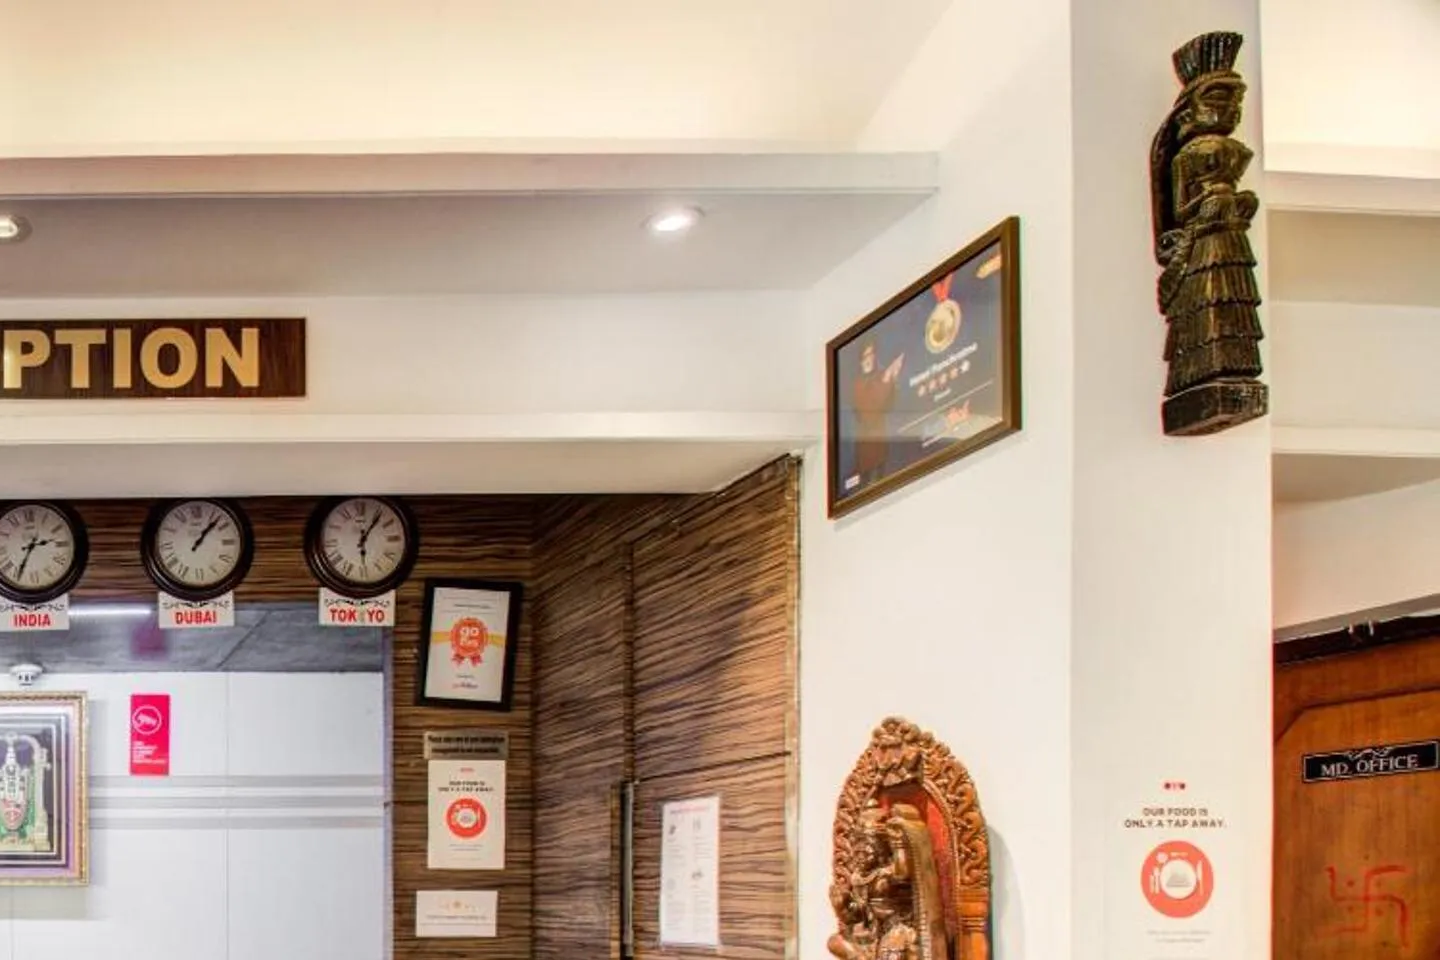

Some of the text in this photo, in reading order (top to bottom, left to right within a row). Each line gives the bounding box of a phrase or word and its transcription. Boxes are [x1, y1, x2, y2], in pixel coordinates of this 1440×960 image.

[13, 612, 51, 628] INDIA
[175, 610, 217, 625] DUBAI
[1356, 753, 1418, 772] OFFICE
[1143, 807, 1208, 816] OUR FOOD IS
[1124, 819, 1153, 828] ONLY
[1156, 819, 1164, 828] A
[1167, 819, 1189, 828] TAP
